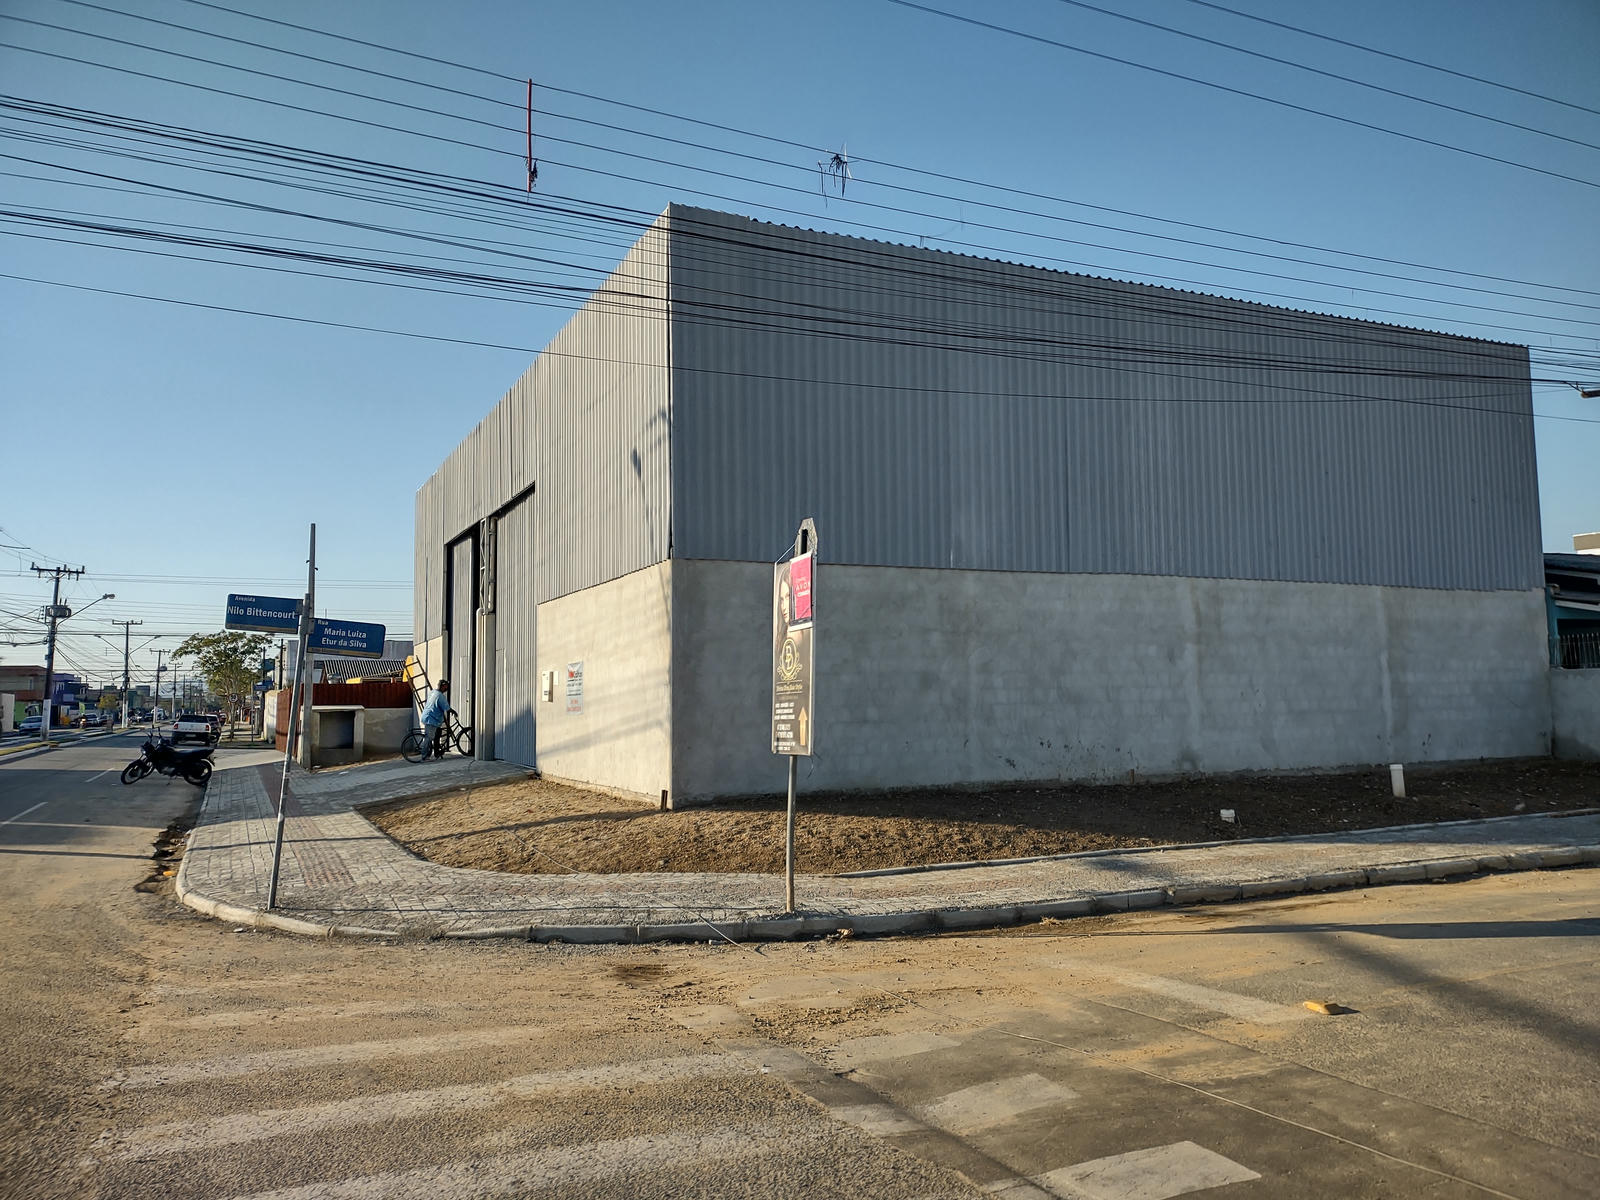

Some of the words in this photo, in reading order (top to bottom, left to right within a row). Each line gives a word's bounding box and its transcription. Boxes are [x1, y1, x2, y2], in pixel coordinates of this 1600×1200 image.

[227, 606, 244, 615] Nilo
[246, 607, 297, 619] Bittencourt
[323, 628, 346, 637] Maria
[347, 630, 367, 638] Luiza
[349, 640, 367, 648] Silva
